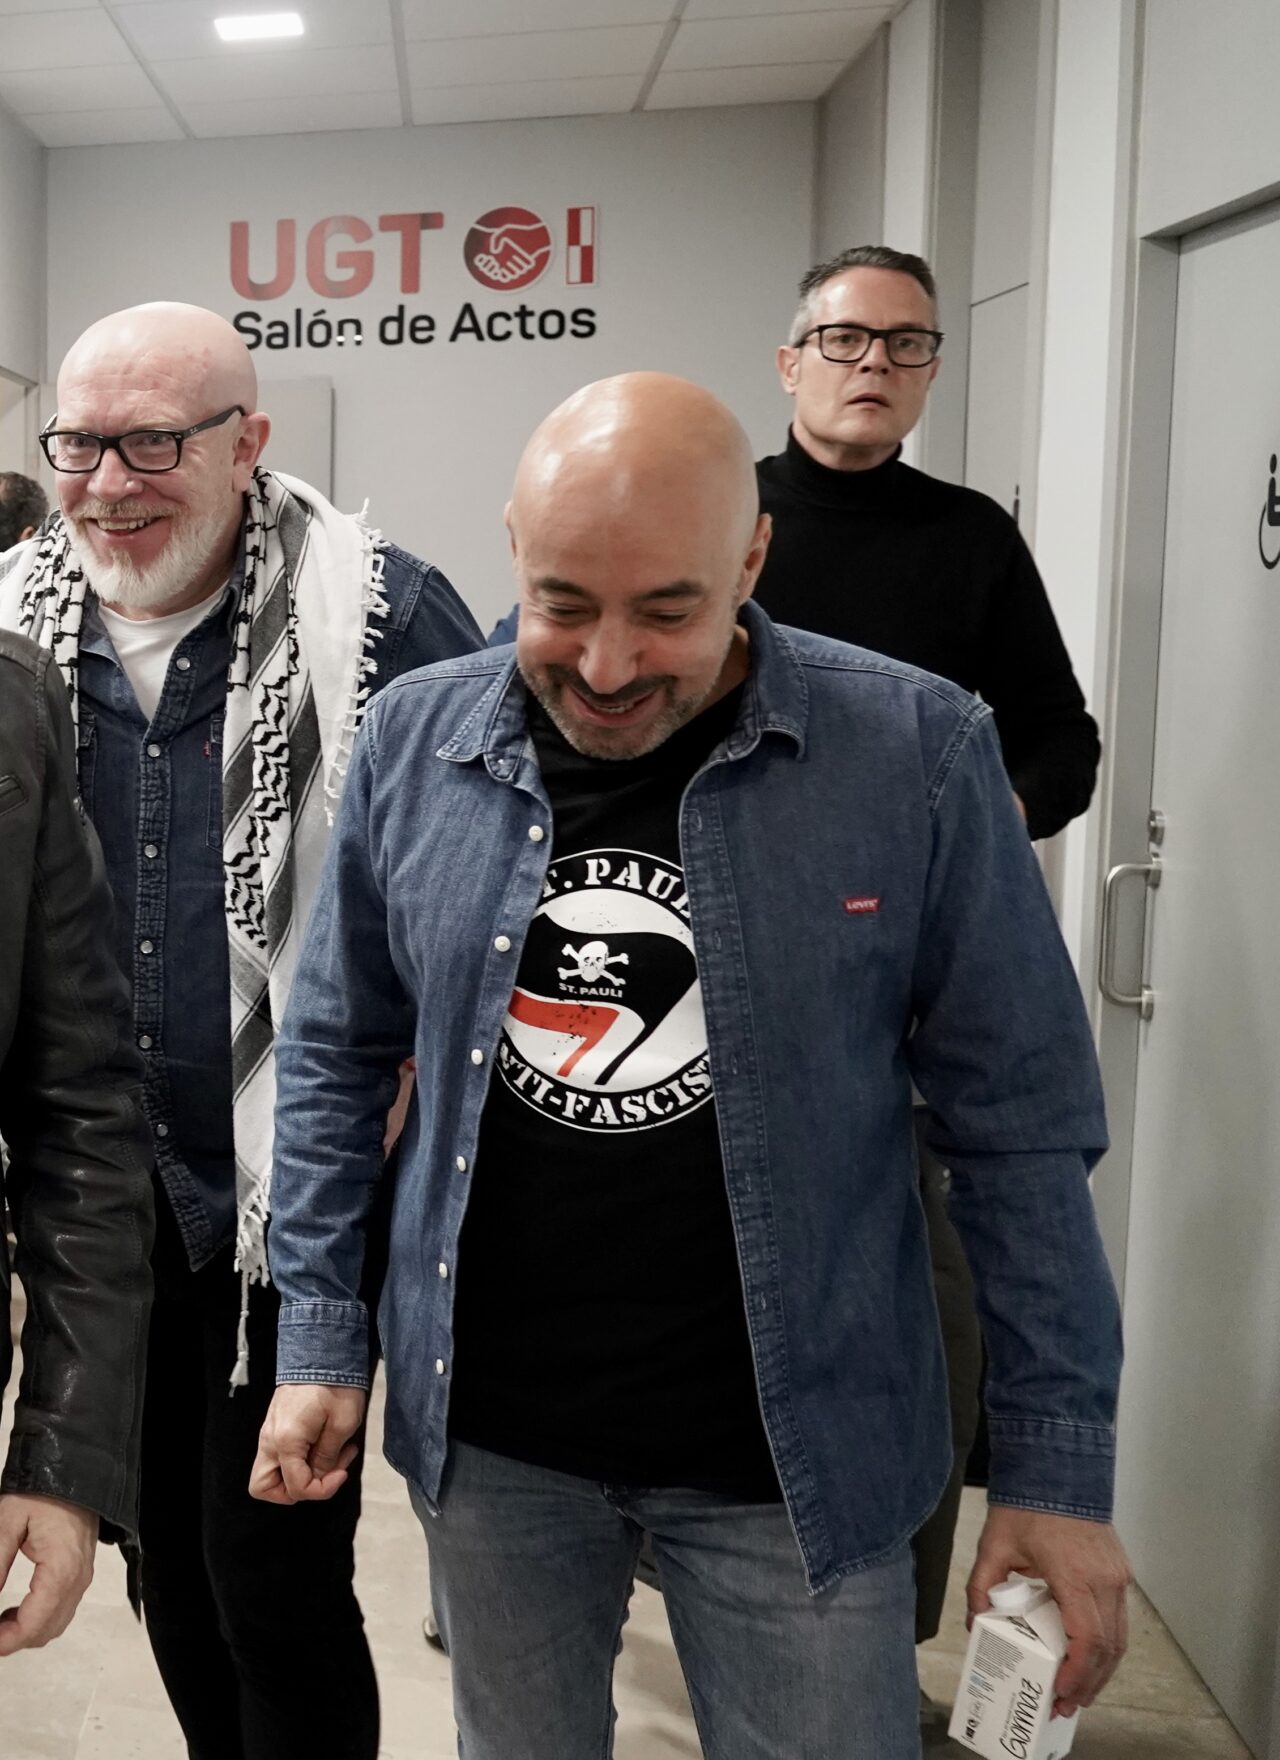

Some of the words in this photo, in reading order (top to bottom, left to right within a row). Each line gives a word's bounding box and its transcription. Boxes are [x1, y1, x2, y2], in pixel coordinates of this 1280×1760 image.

[229, 211, 444, 301] UGT
[233, 308, 362, 350] Salón
[378, 304, 436, 346] de
[449, 303, 597, 342] Actos
[543, 868, 573, 898] T.
[584, 858, 691, 919] PAUL
[559, 982, 578, 994] ST.
[579, 986, 623, 998] PAULI
